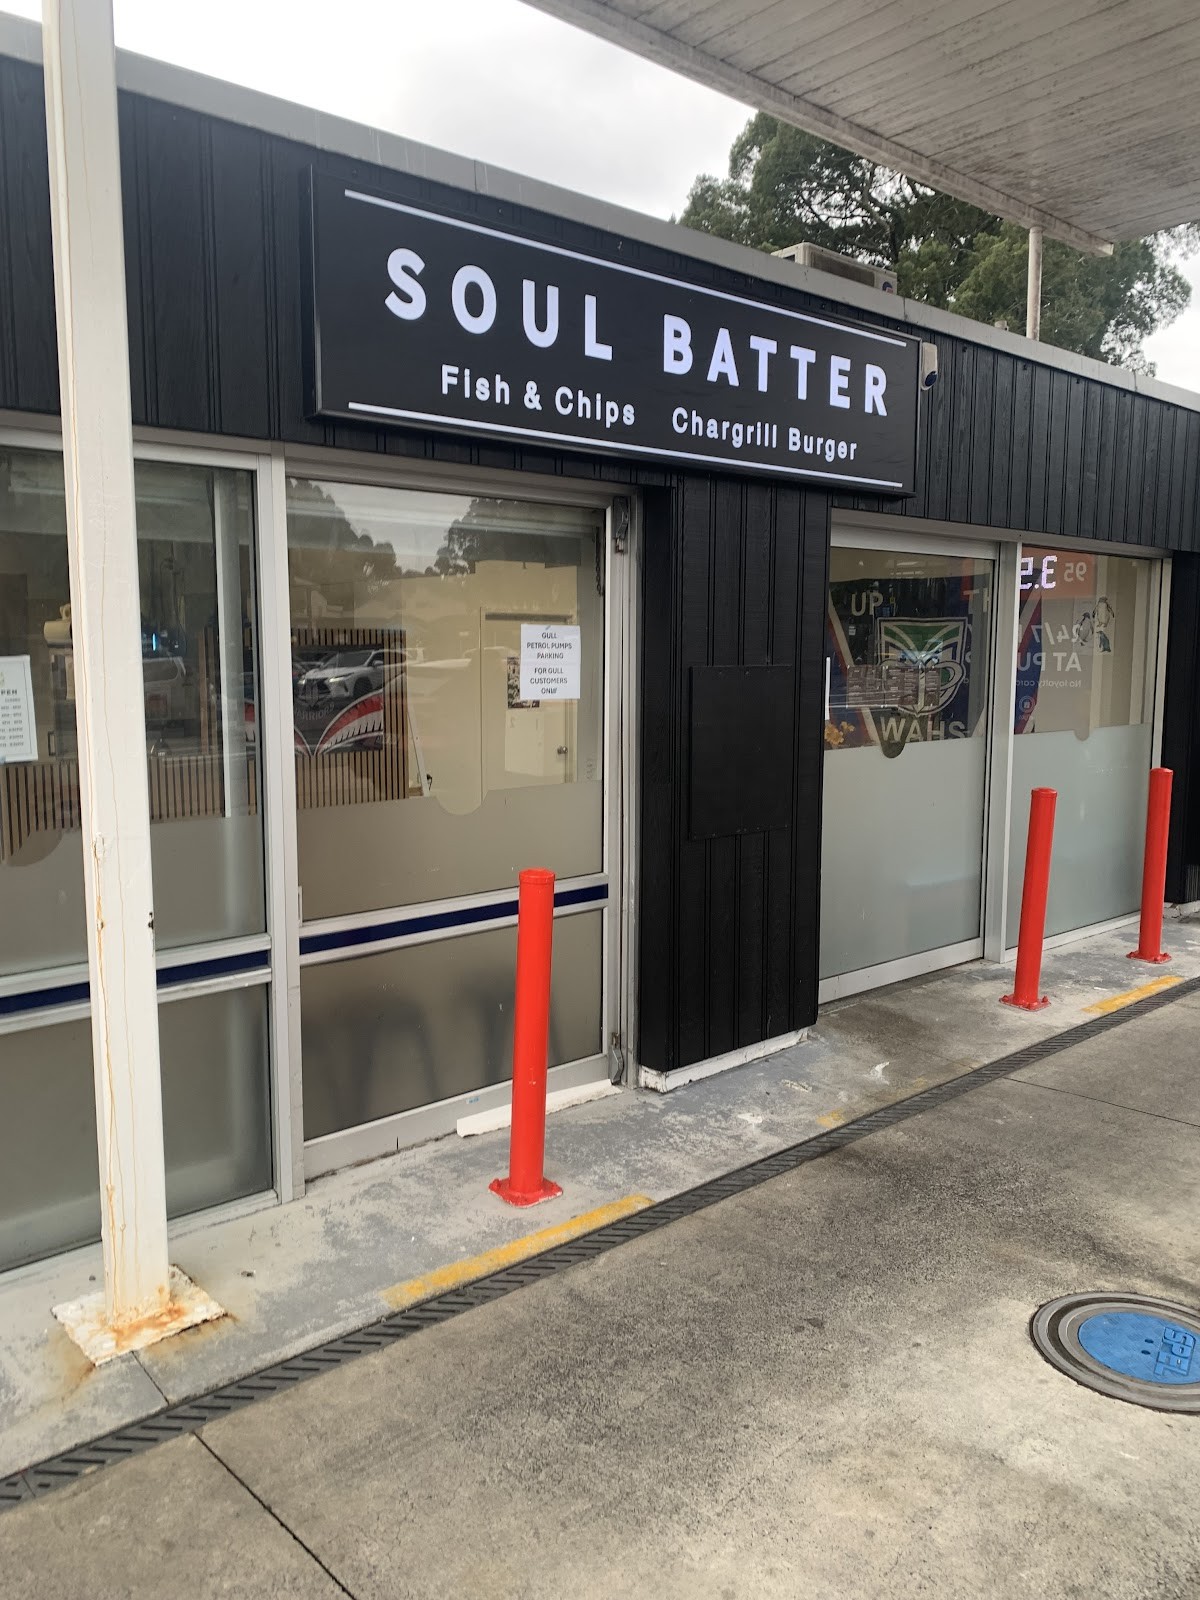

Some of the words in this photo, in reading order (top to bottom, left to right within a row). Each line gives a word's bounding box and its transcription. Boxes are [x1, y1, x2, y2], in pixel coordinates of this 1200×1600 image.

[385, 248, 612, 360] SOUL
[664, 314, 887, 416] BATTER
[442, 364, 509, 405] Fish
[524, 381, 542, 411] &
[555, 387, 635, 428] Chips
[673, 406, 777, 448] Chargrill
[789, 428, 858, 462] Burger
[852, 591, 883, 616] UP
[537, 652, 564, 660] PARKING
[880, 717, 967, 742] WAHS
